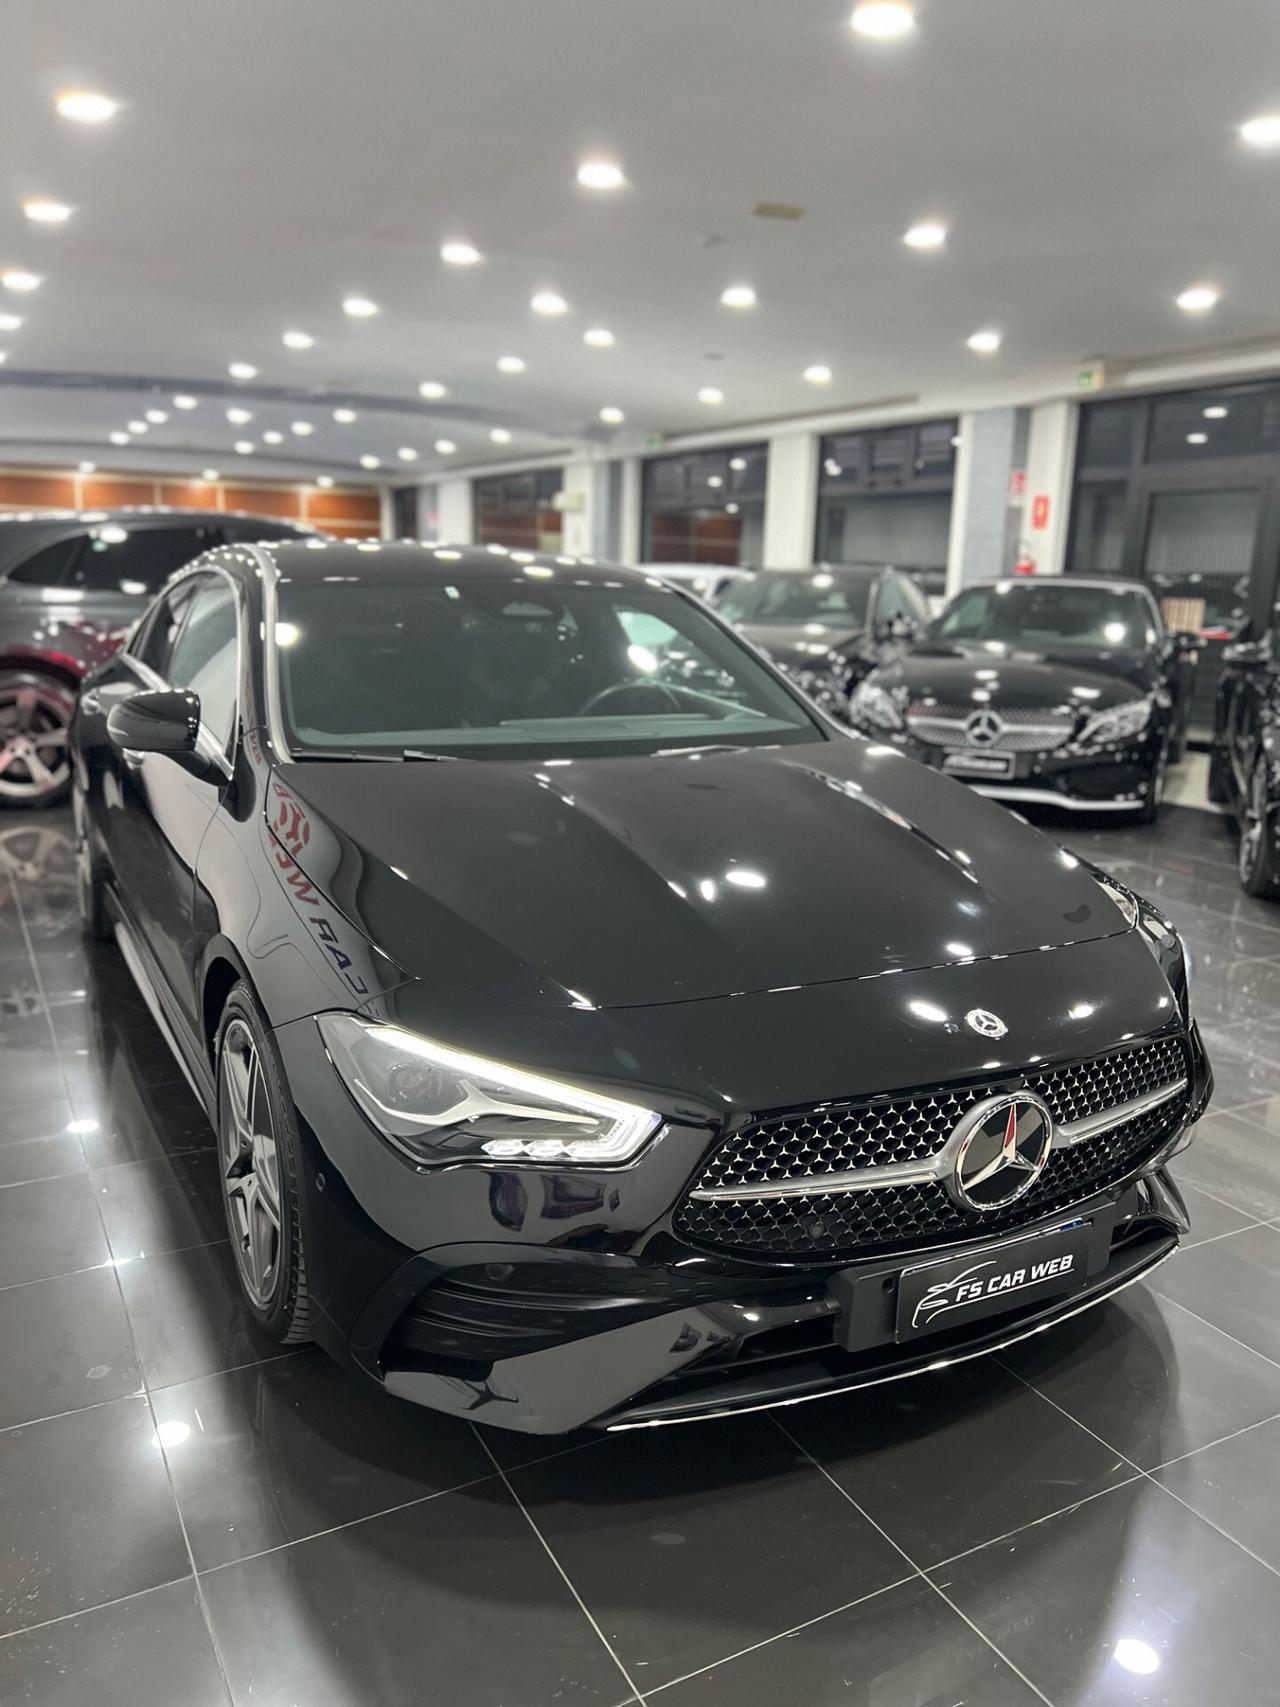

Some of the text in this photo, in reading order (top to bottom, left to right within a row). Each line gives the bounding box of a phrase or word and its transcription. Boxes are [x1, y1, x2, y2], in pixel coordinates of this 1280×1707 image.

[955, 1254, 1074, 1302] FS CAR WEB
